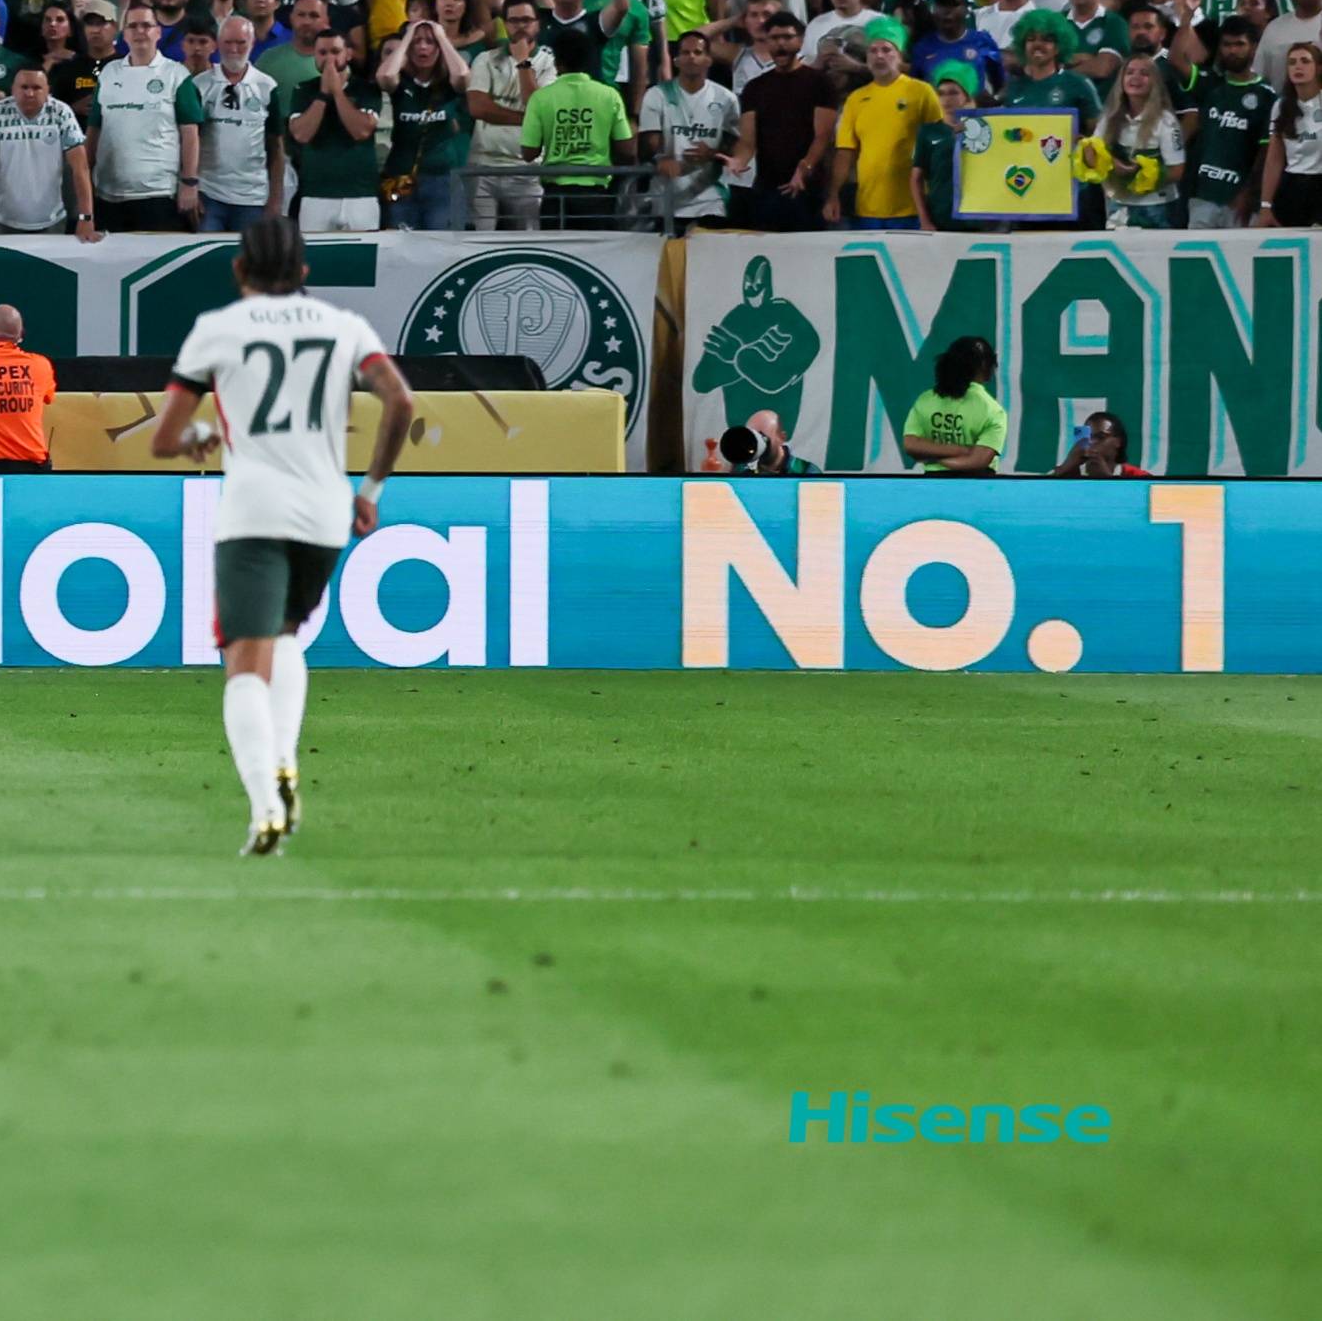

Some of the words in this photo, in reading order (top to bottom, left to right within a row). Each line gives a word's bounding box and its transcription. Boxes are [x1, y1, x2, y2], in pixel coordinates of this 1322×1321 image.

[555, 107, 593, 125] CSC
[555, 125, 592, 142] EVENT
[554, 141, 592, 158] STAFF
[249, 307, 323, 324] GUSTO
[823, 242, 1322, 477] MAN
[242, 337, 338, 437] 27
[930, 411, 964, 431] CSC
[681, 481, 1084, 673] No.
[1150, 484, 1225, 673] 1
